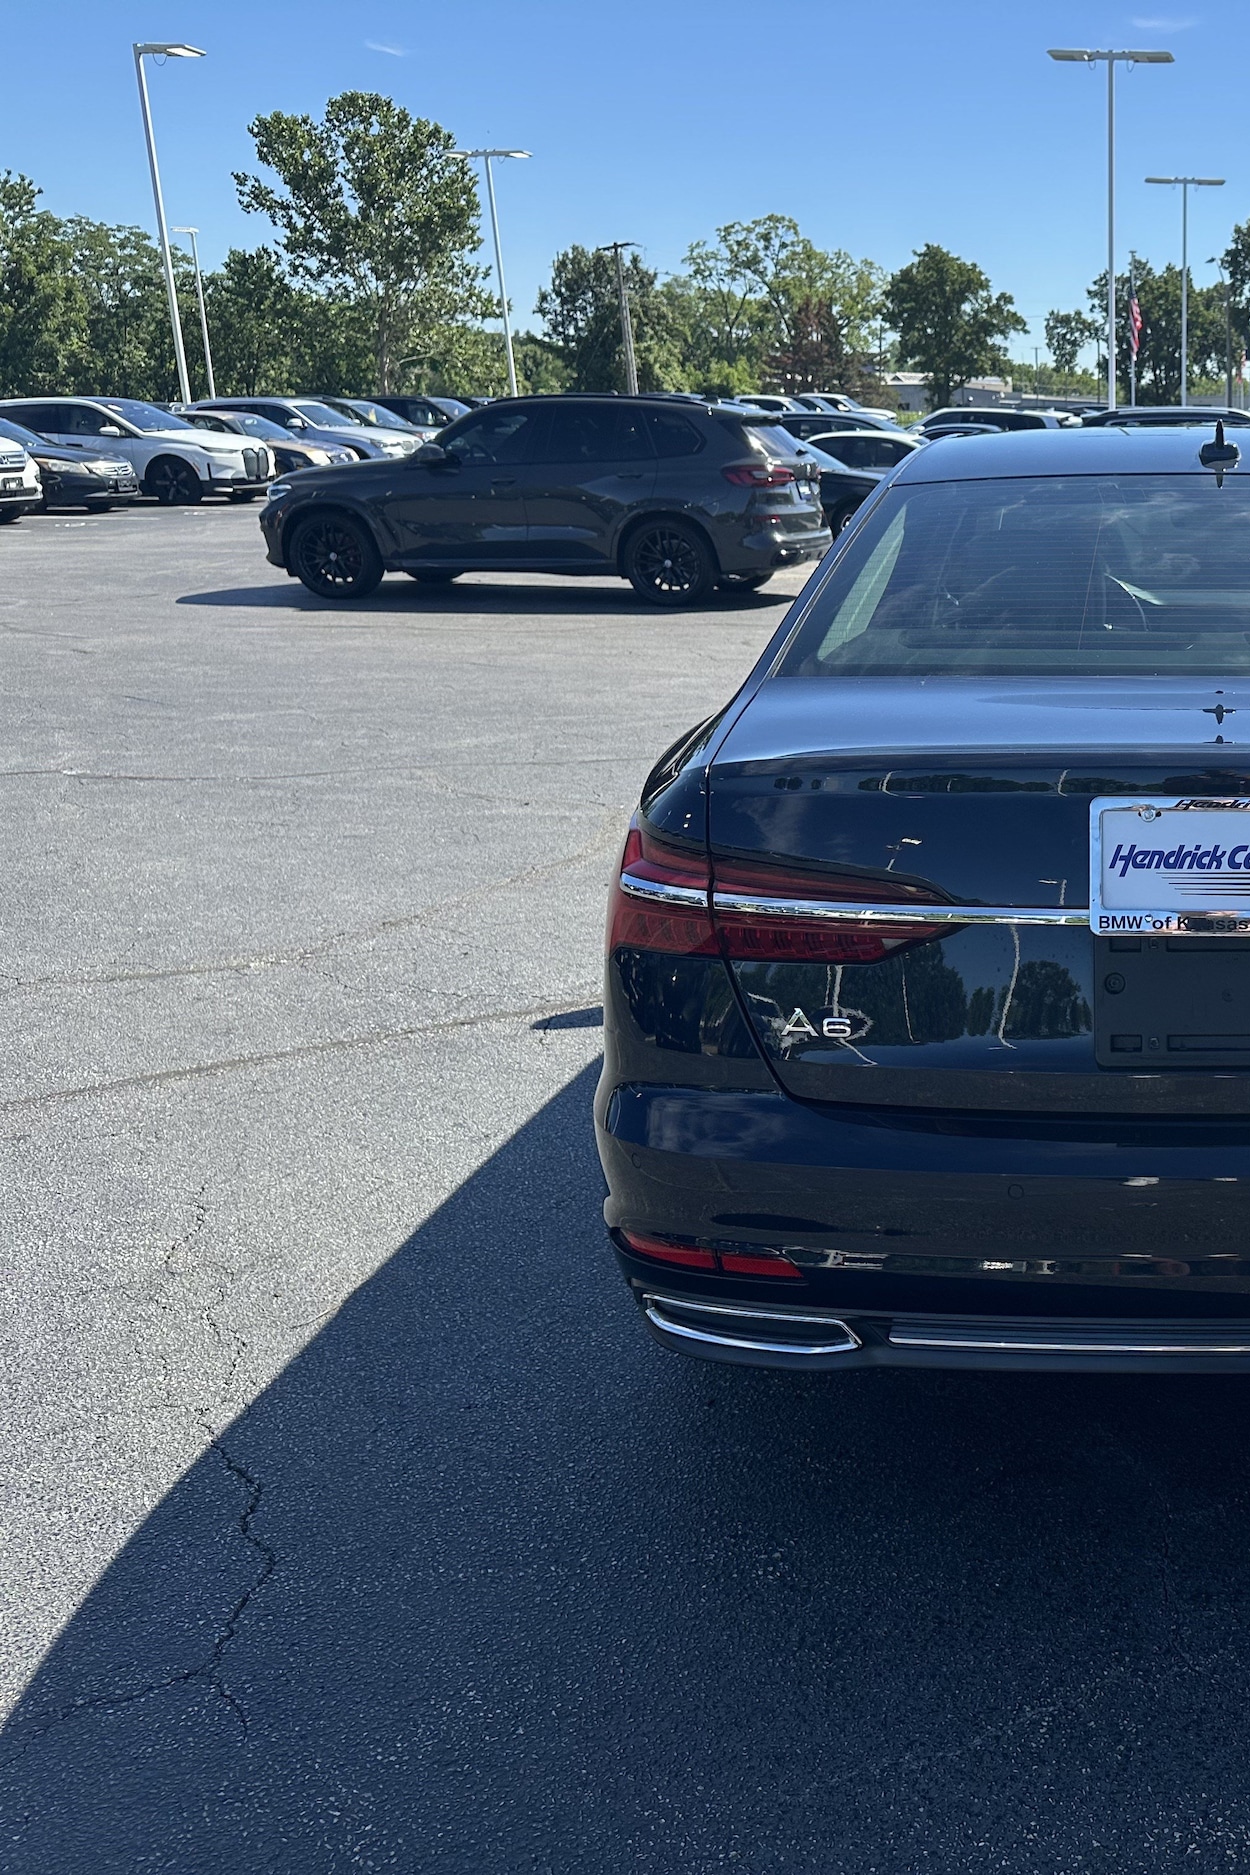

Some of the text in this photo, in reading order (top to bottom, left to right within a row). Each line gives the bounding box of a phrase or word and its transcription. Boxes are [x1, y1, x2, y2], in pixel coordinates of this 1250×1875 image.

[1099, 915, 1143, 930] BMW
[1152, 916, 1172, 930] of
[781, 1007, 852, 1038] A6
